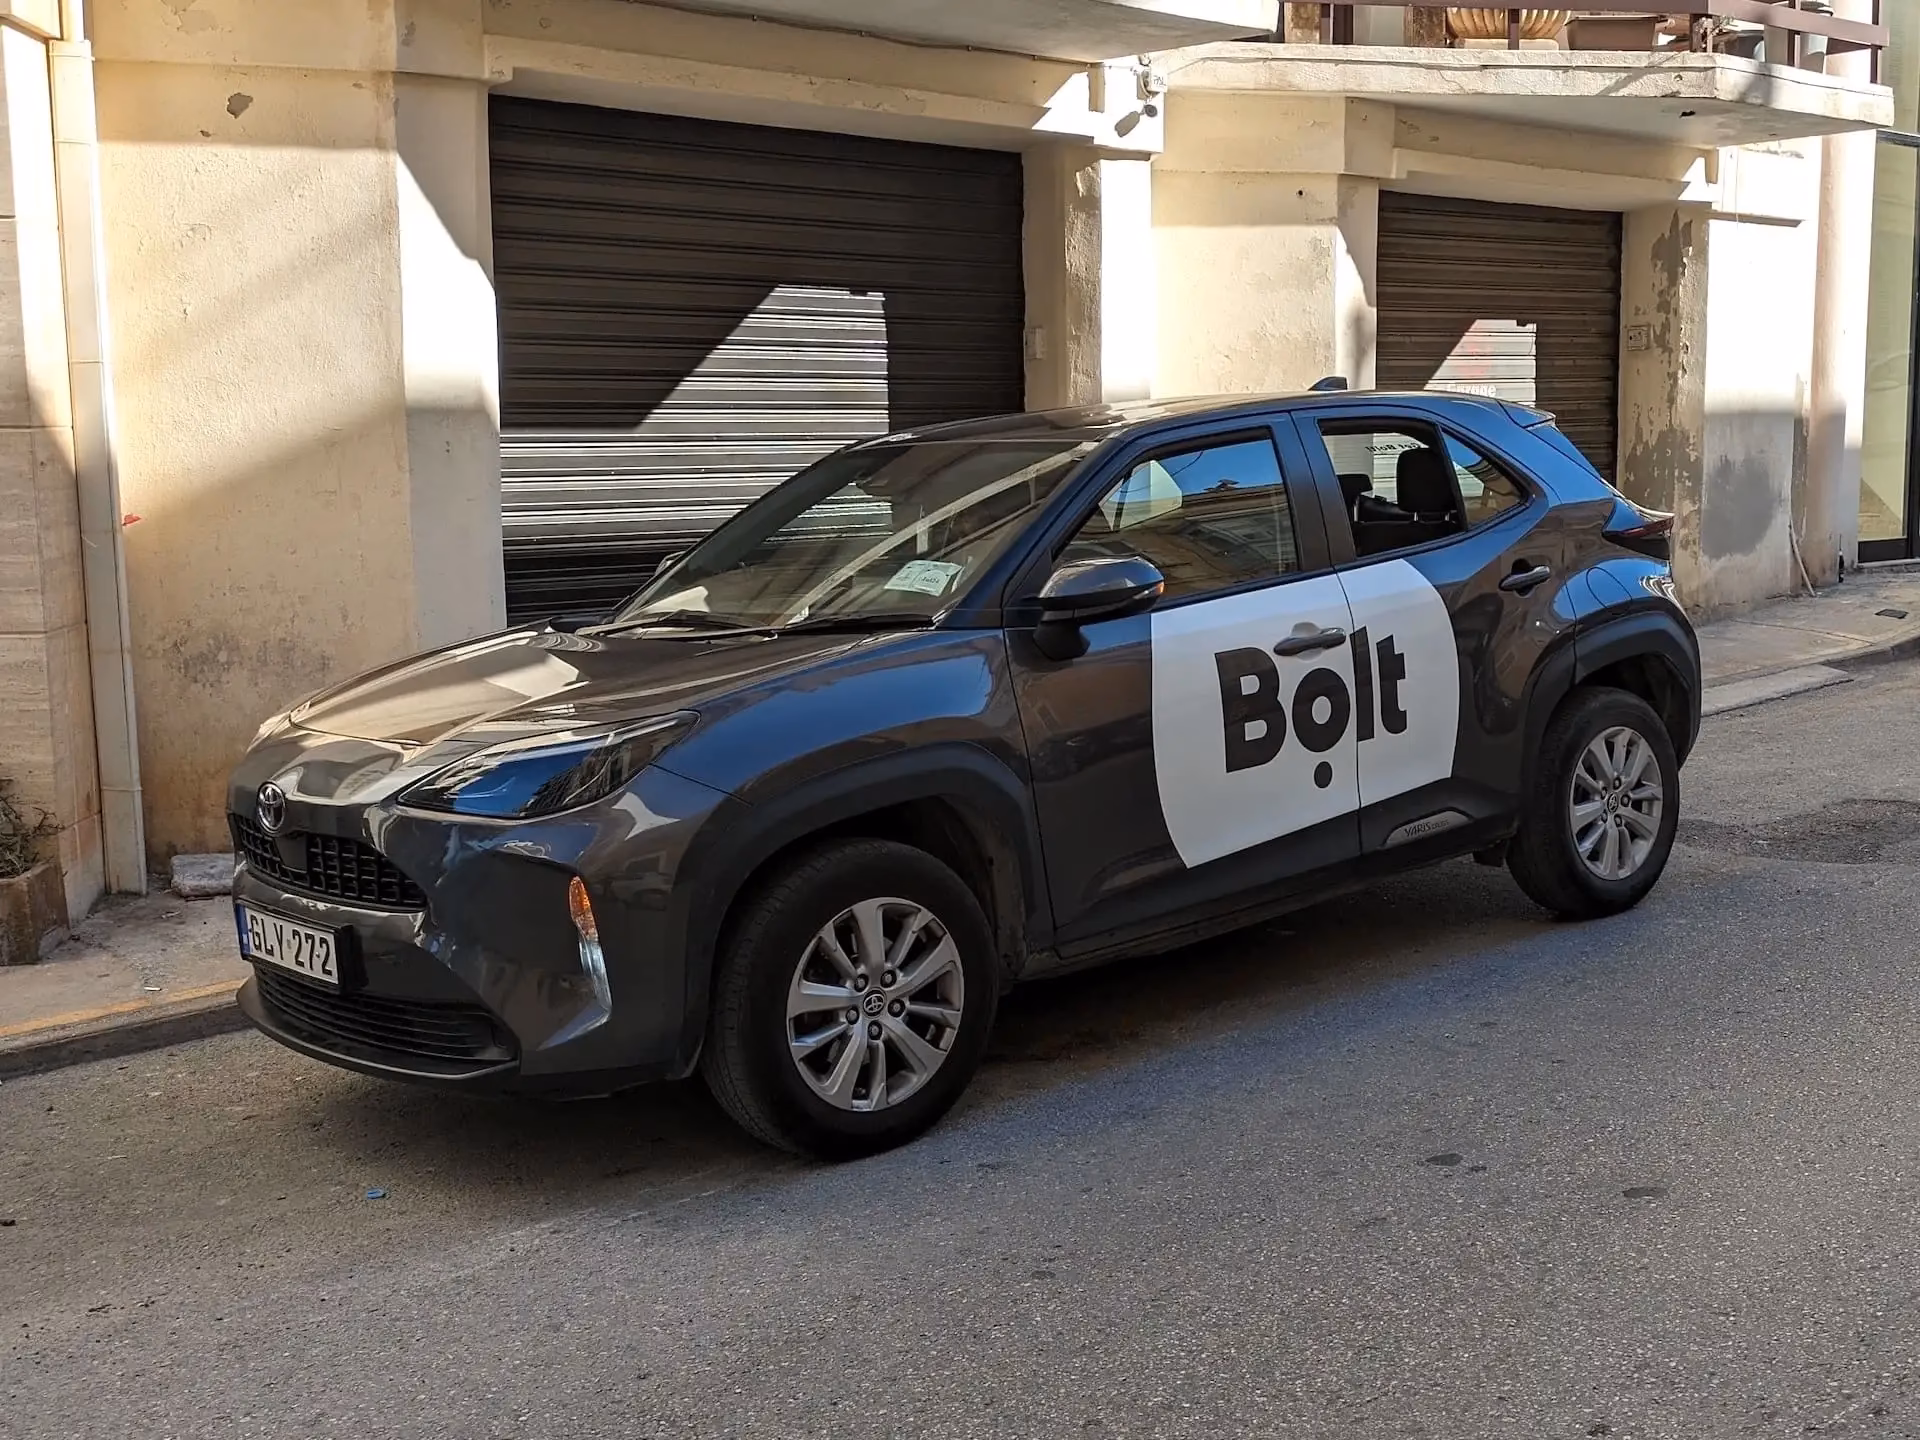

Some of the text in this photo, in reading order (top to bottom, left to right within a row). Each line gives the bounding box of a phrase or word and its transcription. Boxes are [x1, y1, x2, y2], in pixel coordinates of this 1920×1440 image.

[1214, 625, 1408, 775] Bolt
[249, 914, 333, 977] GLY 272
